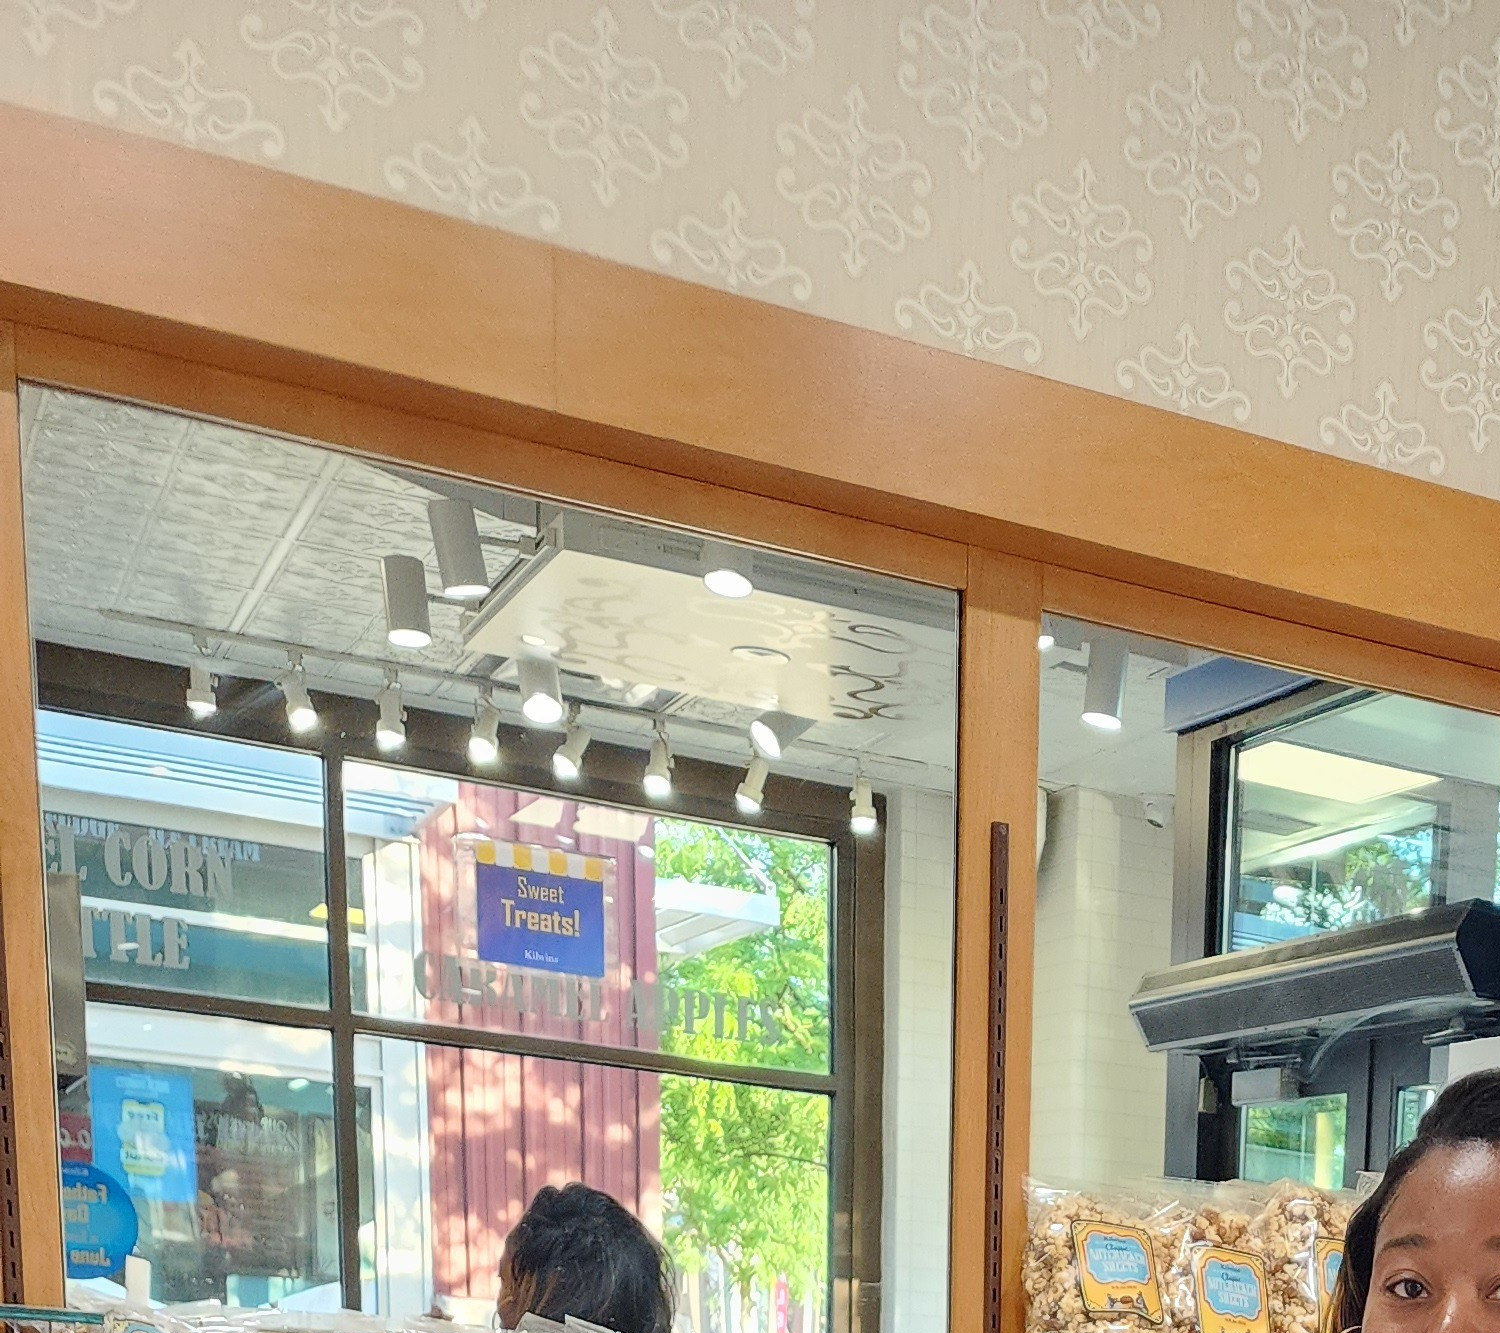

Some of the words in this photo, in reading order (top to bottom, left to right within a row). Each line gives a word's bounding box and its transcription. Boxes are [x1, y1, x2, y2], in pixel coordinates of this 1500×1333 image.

[105, 829, 233, 900] CORN
[517, 876, 564, 904] Sweet
[500, 899, 581, 937] Treats!
